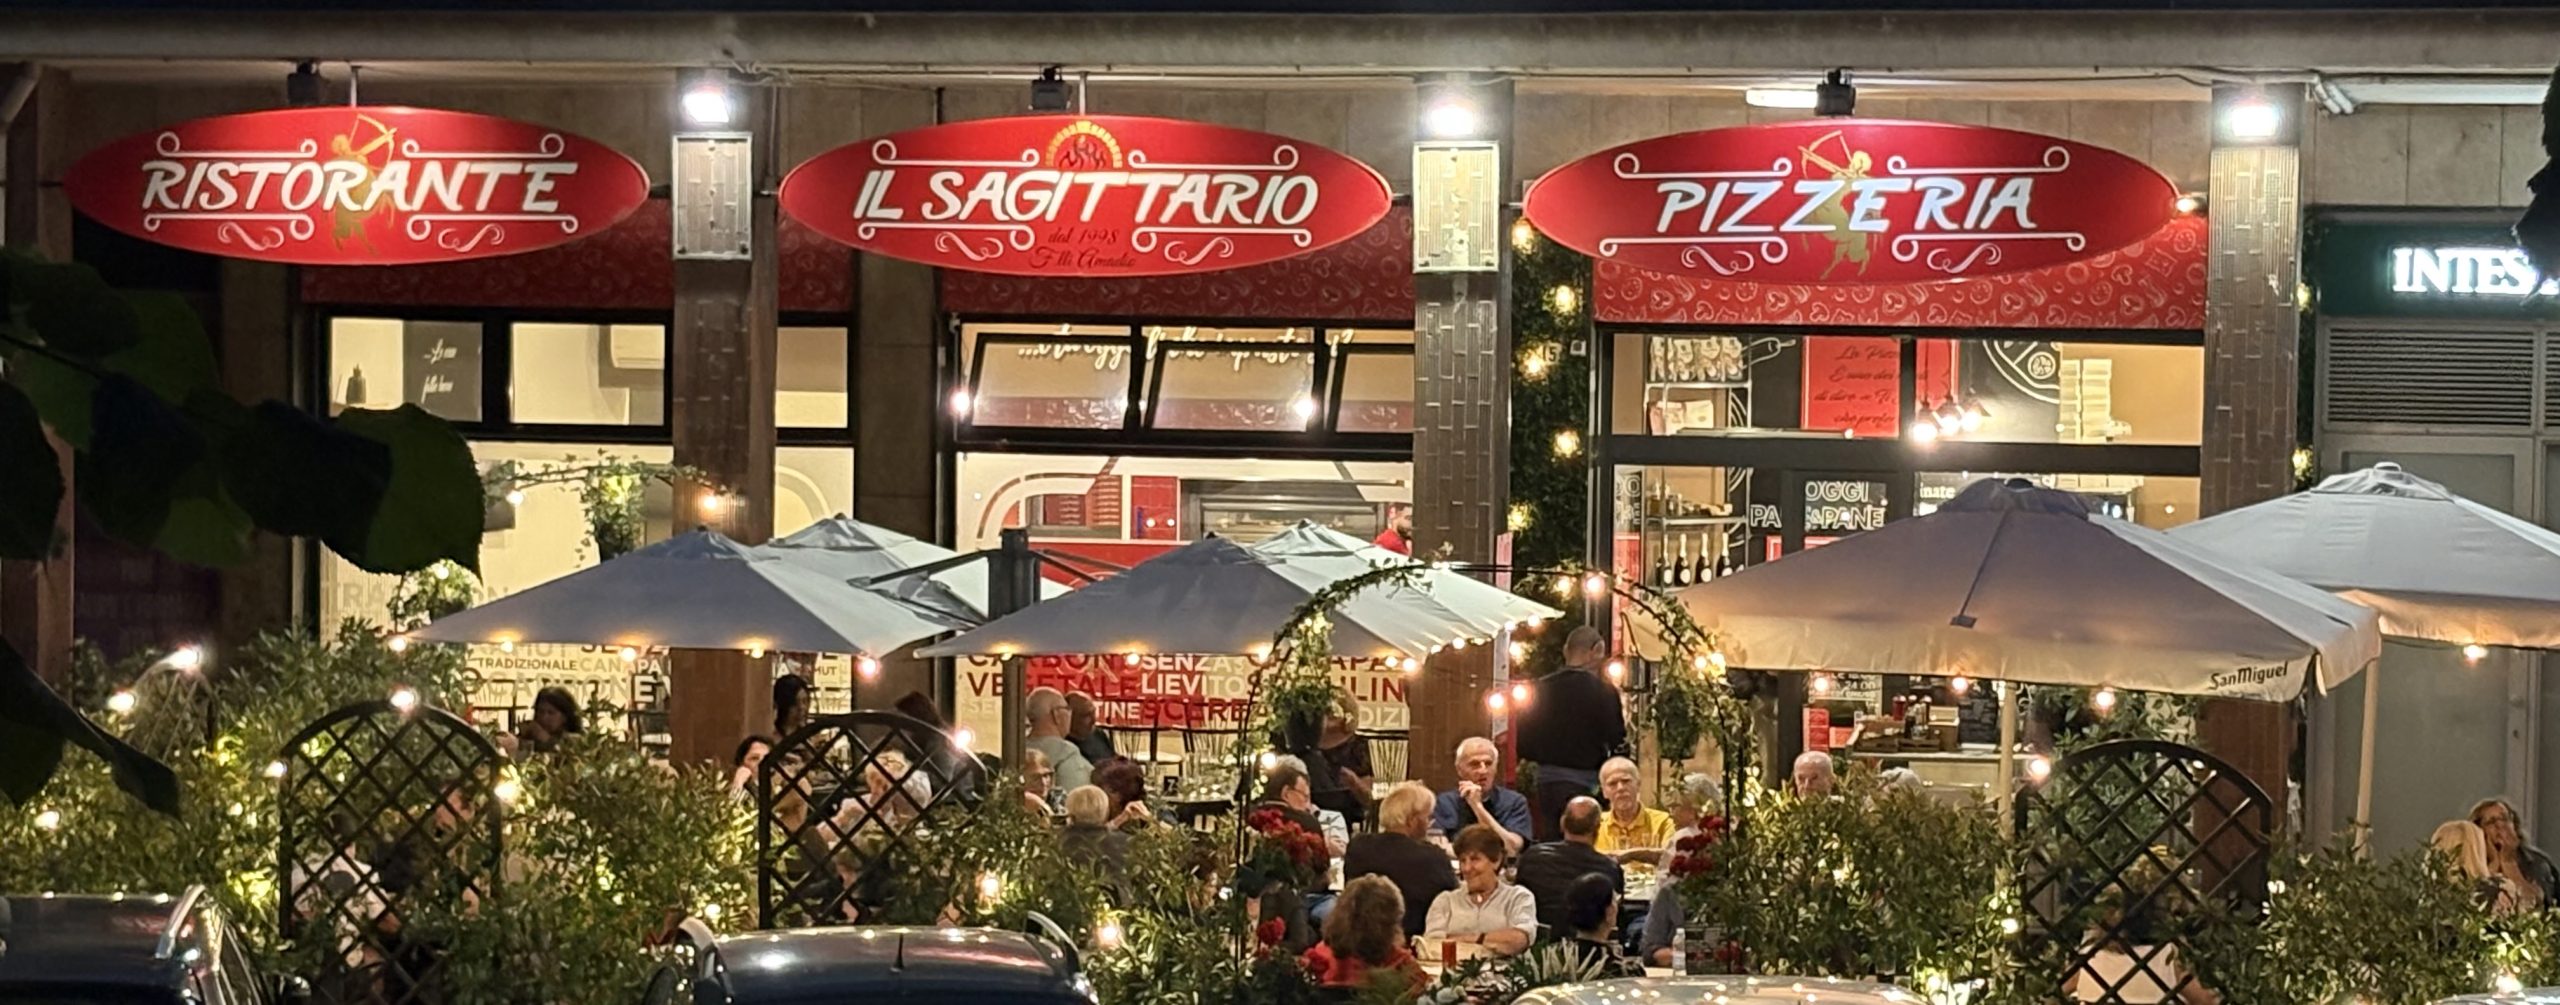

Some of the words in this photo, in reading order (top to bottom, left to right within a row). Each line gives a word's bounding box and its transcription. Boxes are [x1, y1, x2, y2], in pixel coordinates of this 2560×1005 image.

[142, 160, 578, 212] RISTORANTE
[854, 170, 904, 220] IL
[922, 170, 1319, 225] SAGITTARIO
[1656, 177, 2037, 233] PIZZERIA
[2393, 247, 2559, 294] INTES
[1805, 481, 1869, 502] OGGI
[477, 657, 578, 671] TRADIZIONALE
[1141, 673, 1246, 696] LIEVITO
